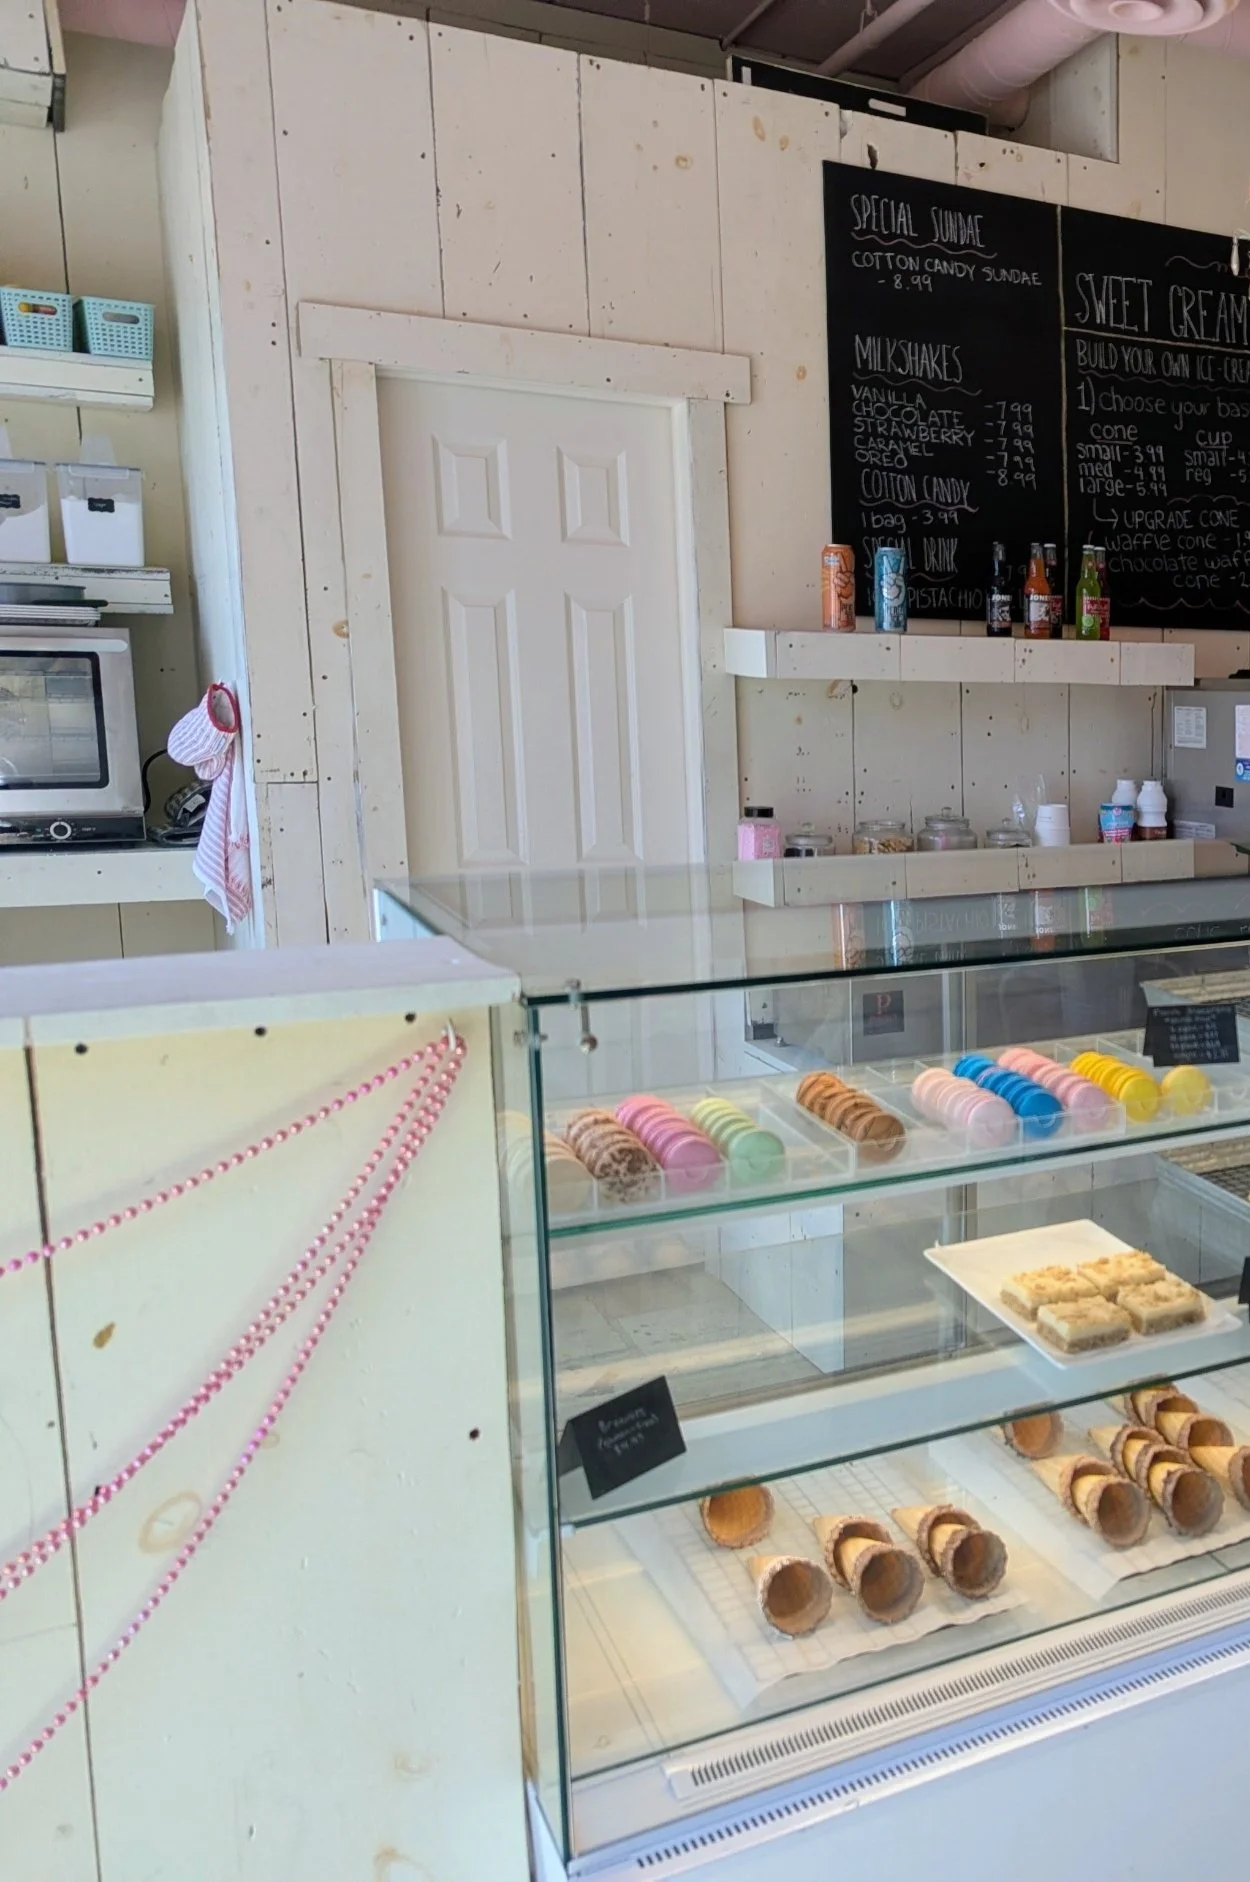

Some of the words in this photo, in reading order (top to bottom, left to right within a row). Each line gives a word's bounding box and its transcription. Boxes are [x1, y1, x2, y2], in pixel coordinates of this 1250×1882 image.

[851, 193, 918, 237] SPECIAL
[930, 206, 985, 248] SUNDAE
[852, 251, 920, 271] COTTON
[924, 258, 976, 282] CANDY
[982, 266, 1042, 286] SUNDAE
[893, 274, 933, 292] 8.99
[1074, 272, 1153, 332] SWEET
[1169, 284, 1249, 346] CREAM
[854, 334, 963, 383] MILKSHAKES
[1076, 338, 1118, 370] BUILD
[1121, 345, 1157, 376] YOUR
[1161, 351, 1190, 379] OWN
[851, 384, 927, 410] VANILLA
[852, 401, 965, 429] CHOCOLATE
[995, 401, 1033, 423] 799
[1100, 386, 1168, 415] choose
[1171, 399, 1211, 431] your
[853, 417, 976, 447] STRAWBERRY
[996, 420, 1034, 439] 799
[854, 435, 934, 457] CARAMEL
[996, 437, 1034, 454] 799
[1076, 443, 1121, 463] small
[855, 450, 908, 469] OREO
[996, 452, 1036, 472] 799
[1078, 461, 1113, 478] med
[1184, 450, 1227, 467] small
[861, 468, 917, 501] COTTON
[923, 475, 971, 504] CANDY
[1079, 477, 1126, 497] large
[1185, 467, 1212, 486] reg
[871, 511, 906, 534] bag
[1123, 509, 1194, 530] UPGRADE
[1200, 509, 1241, 529] CONE
[1104, 533, 1171, 551] waffle
[1176, 533, 1218, 549] cone
[923, 538, 959, 573] DRINK
[1108, 553, 1198, 572] chocolate
[1173, 574, 1221, 590] cone
[908, 587, 983, 610] PISTACHIO
